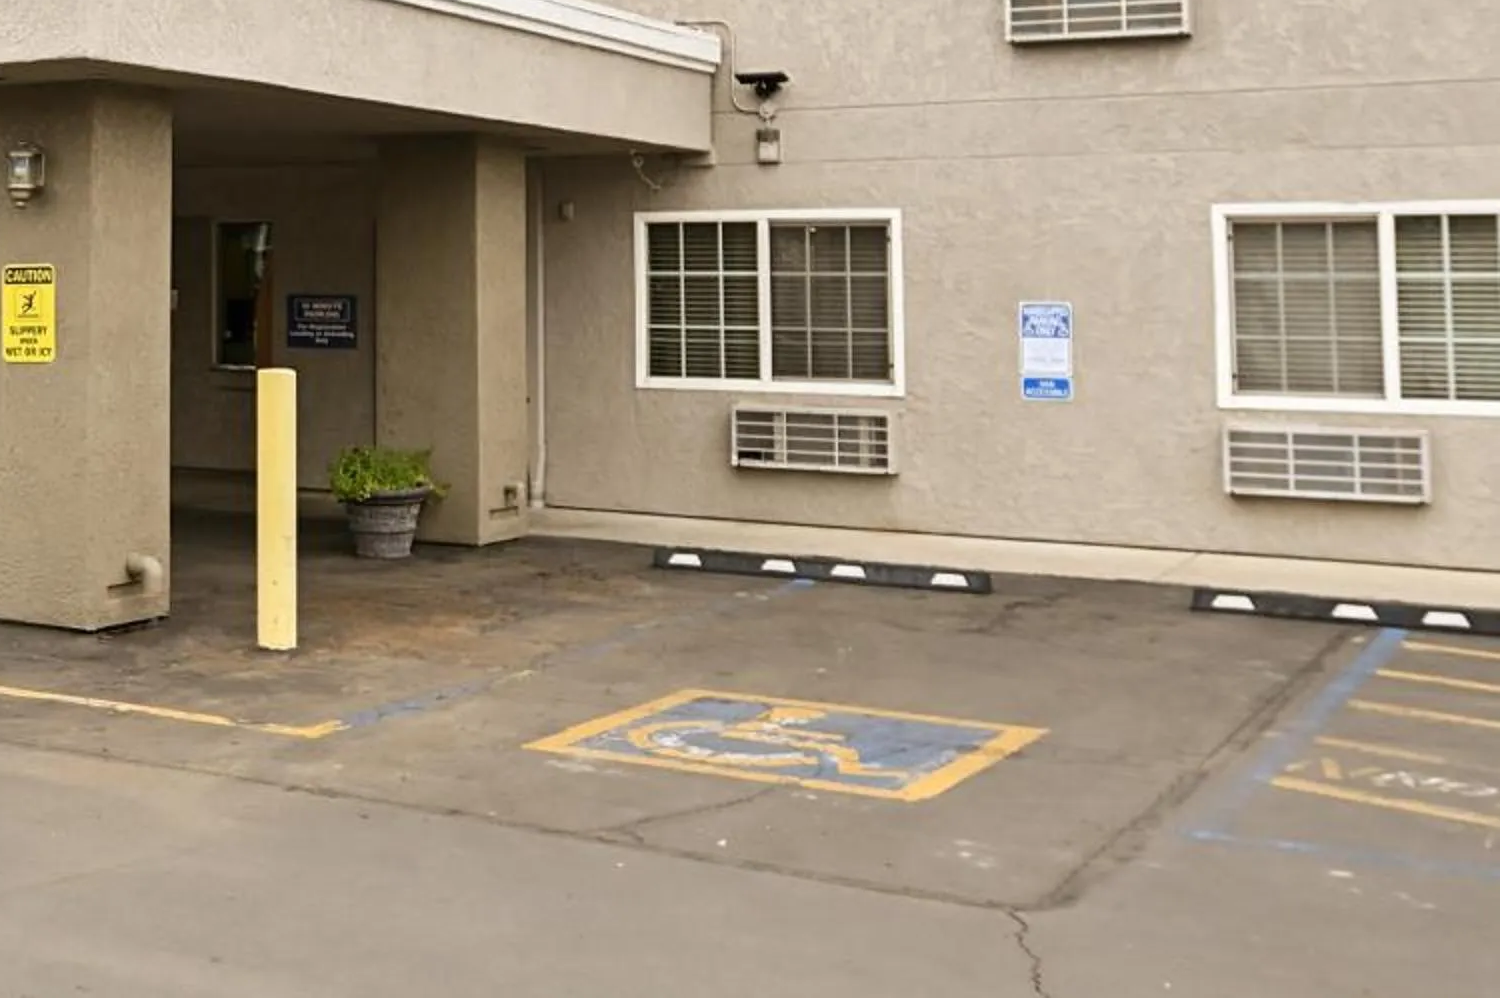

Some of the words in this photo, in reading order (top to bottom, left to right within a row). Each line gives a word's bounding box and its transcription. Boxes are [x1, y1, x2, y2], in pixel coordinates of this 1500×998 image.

[6, 268, 52, 283] CAUTION
[9, 325, 47, 335] SLIPPERY
[5, 347, 22, 356] WET
[24, 347, 37, 356] OR
[40, 347, 52, 356] ICY
